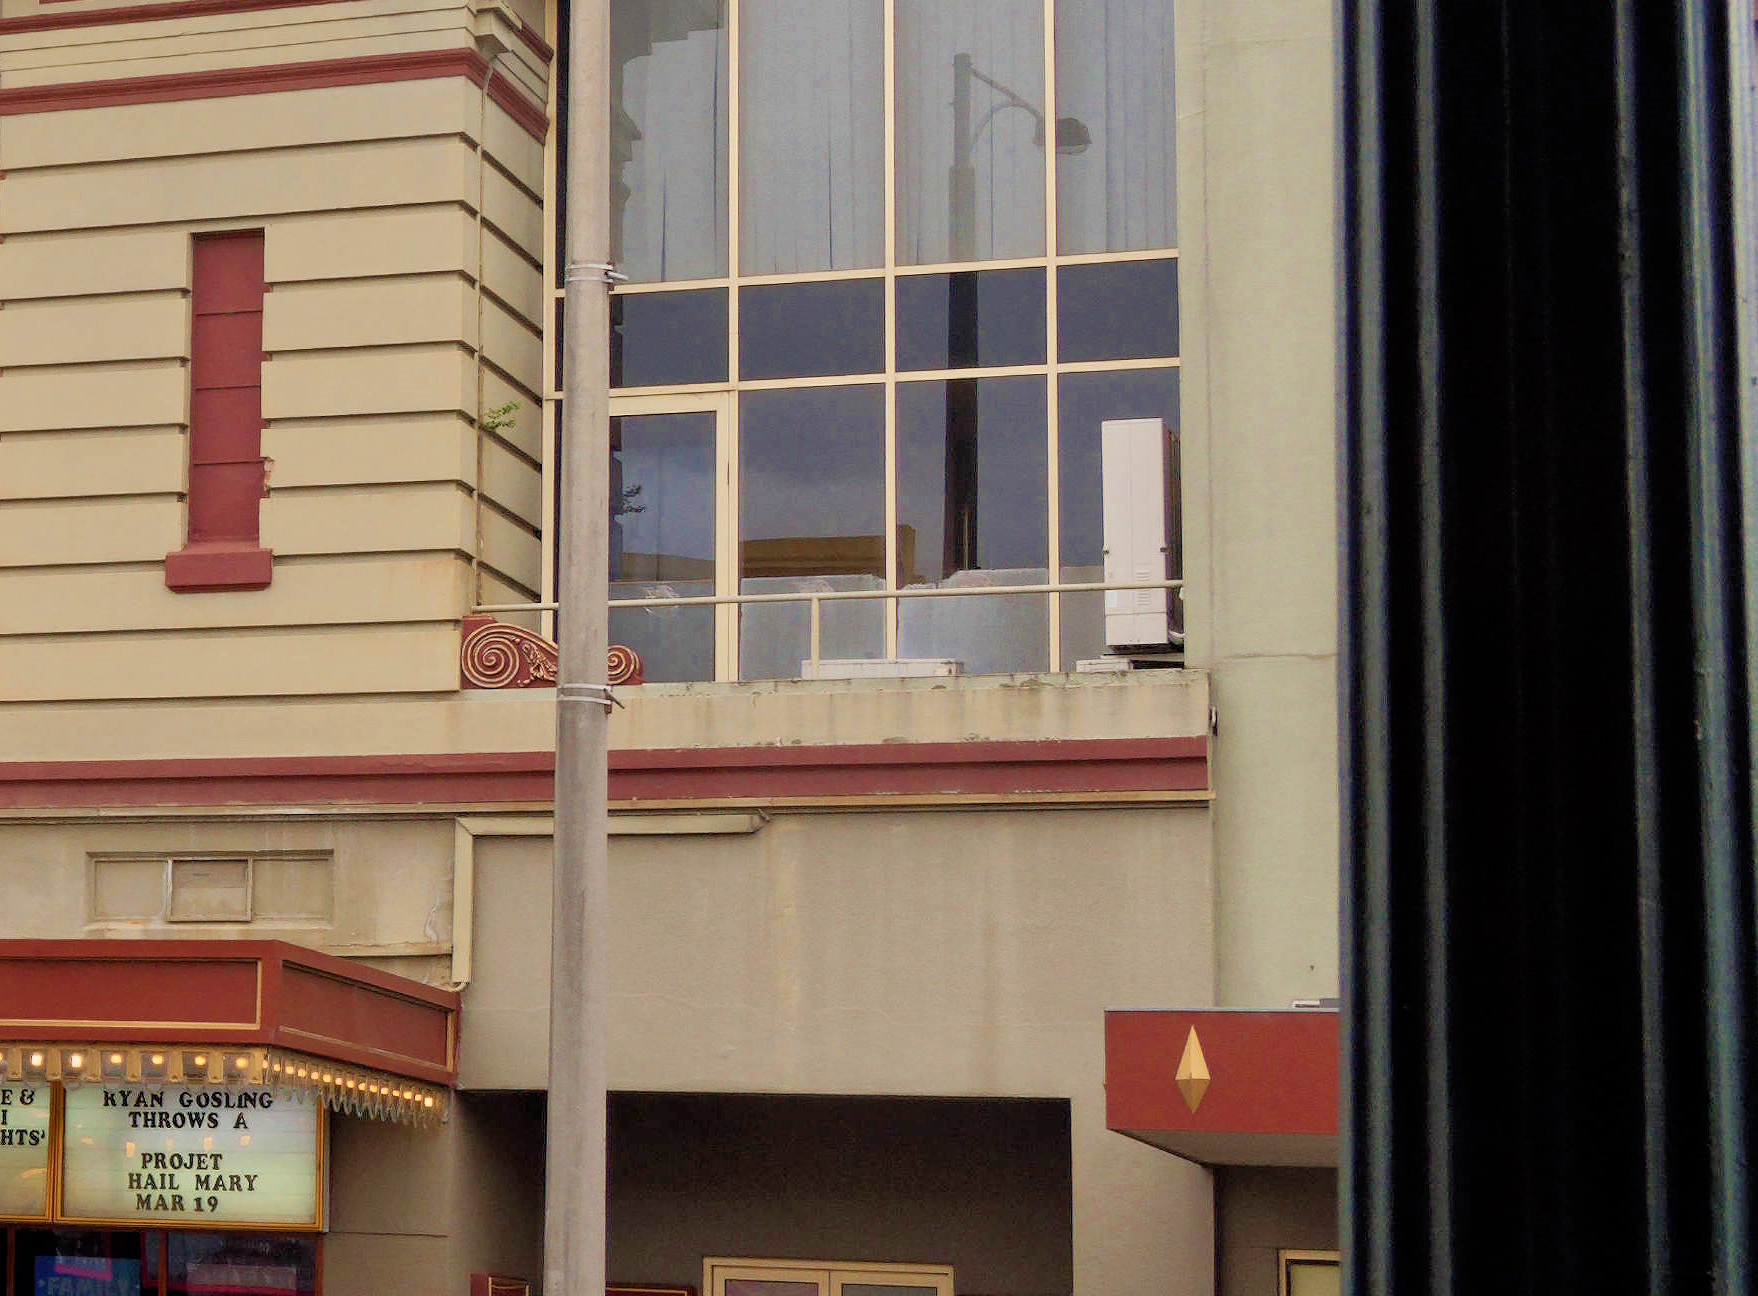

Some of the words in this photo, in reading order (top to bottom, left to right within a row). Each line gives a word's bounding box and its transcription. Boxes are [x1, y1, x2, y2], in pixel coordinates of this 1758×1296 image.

[19, 1089, 34, 1105] &
[178, 1091, 274, 1109] GOSLING
[128, 1112, 219, 1129] THROWS
[233, 1112, 249, 1129] A
[140, 1152, 223, 1170] PROJET
[127, 1173, 180, 1191] HAIL
[194, 1174, 259, 1192] MARY
[135, 1194, 185, 1211] MAR
[194, 1196, 219, 1213] 19
